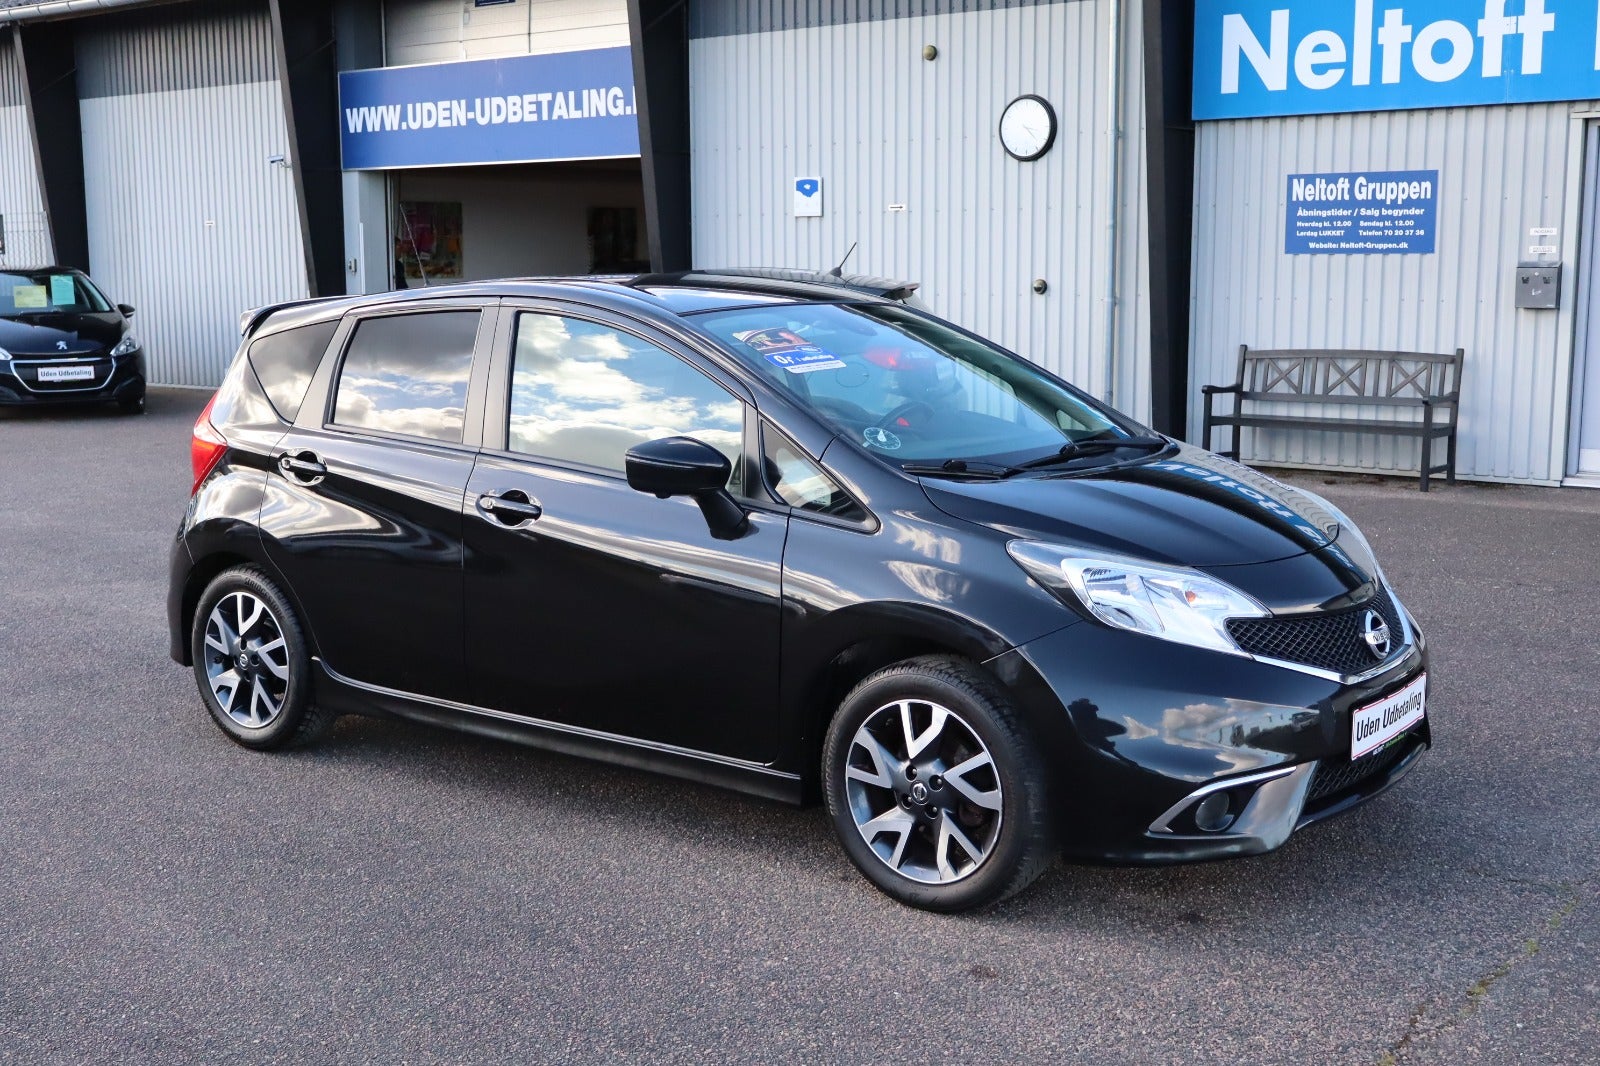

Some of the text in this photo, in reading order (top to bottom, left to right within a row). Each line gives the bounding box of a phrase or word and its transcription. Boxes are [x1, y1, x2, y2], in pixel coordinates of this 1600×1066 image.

[1220, 0, 1555, 94] Neltoft
[345, 85, 638, 134] WWW.UDEN-UDBETALING.
[1292, 176, 1432, 204] Neltoft Gruppen
[1297, 206, 1352, 218] Åbningstider
[1360, 208, 1379, 217] Salg
[1381, 207, 1425, 217] begynder
[1339, 241, 1409, 250] Neltoft-Gruppen.dk
[58, 369, 92, 378] Udbetaling
[1356, 691, 1422, 742] Uden Udbetaling
